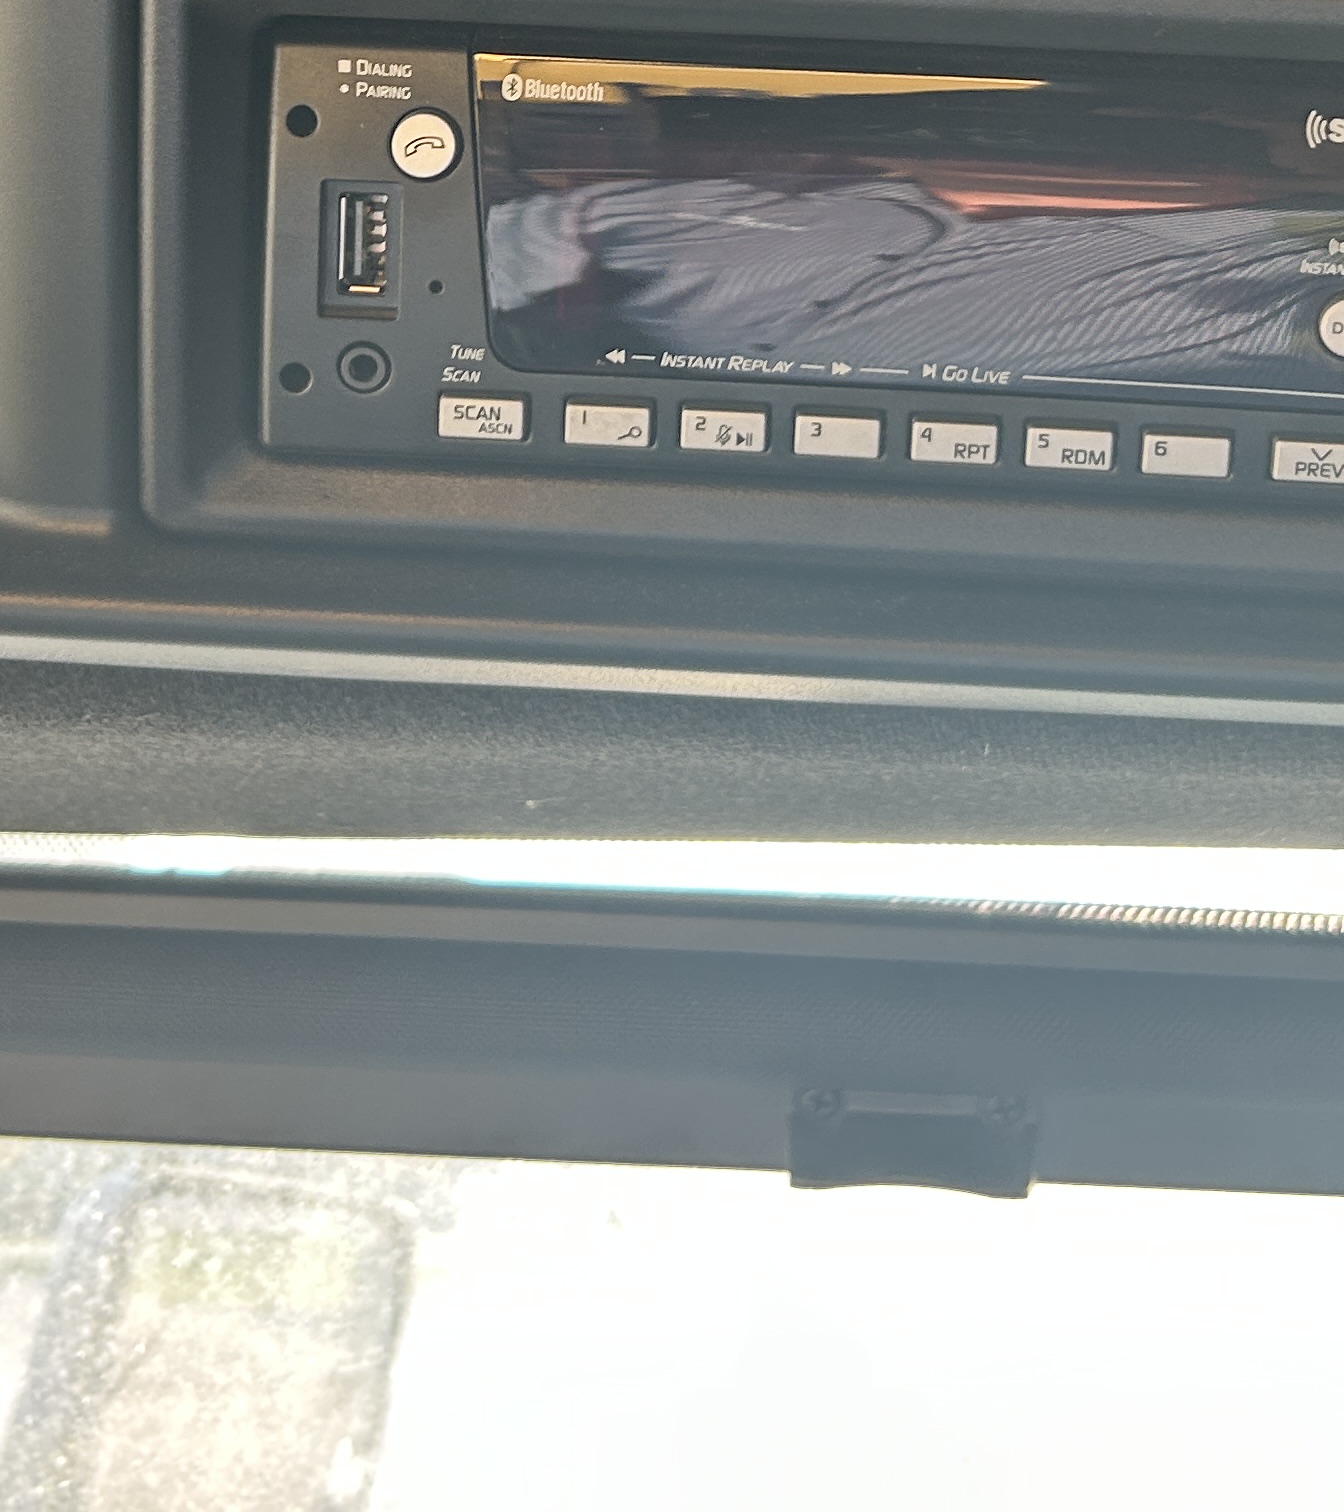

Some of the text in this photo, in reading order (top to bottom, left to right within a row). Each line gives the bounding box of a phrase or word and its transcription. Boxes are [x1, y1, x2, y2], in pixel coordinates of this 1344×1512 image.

[524, 78, 605, 103] Bluetooth
[452, 403, 502, 423] SCAN
[581, 410, 588, 426] 1
[477, 420, 513, 436] ASCN
[694, 416, 707, 432] 2
[810, 423, 822, 438] 3
[920, 427, 932, 442] 4
[1038, 433, 1050, 448] 5
[953, 443, 990, 461] RPT
[1154, 440, 1167, 455] 6
[1060, 447, 1107, 467] RDM
